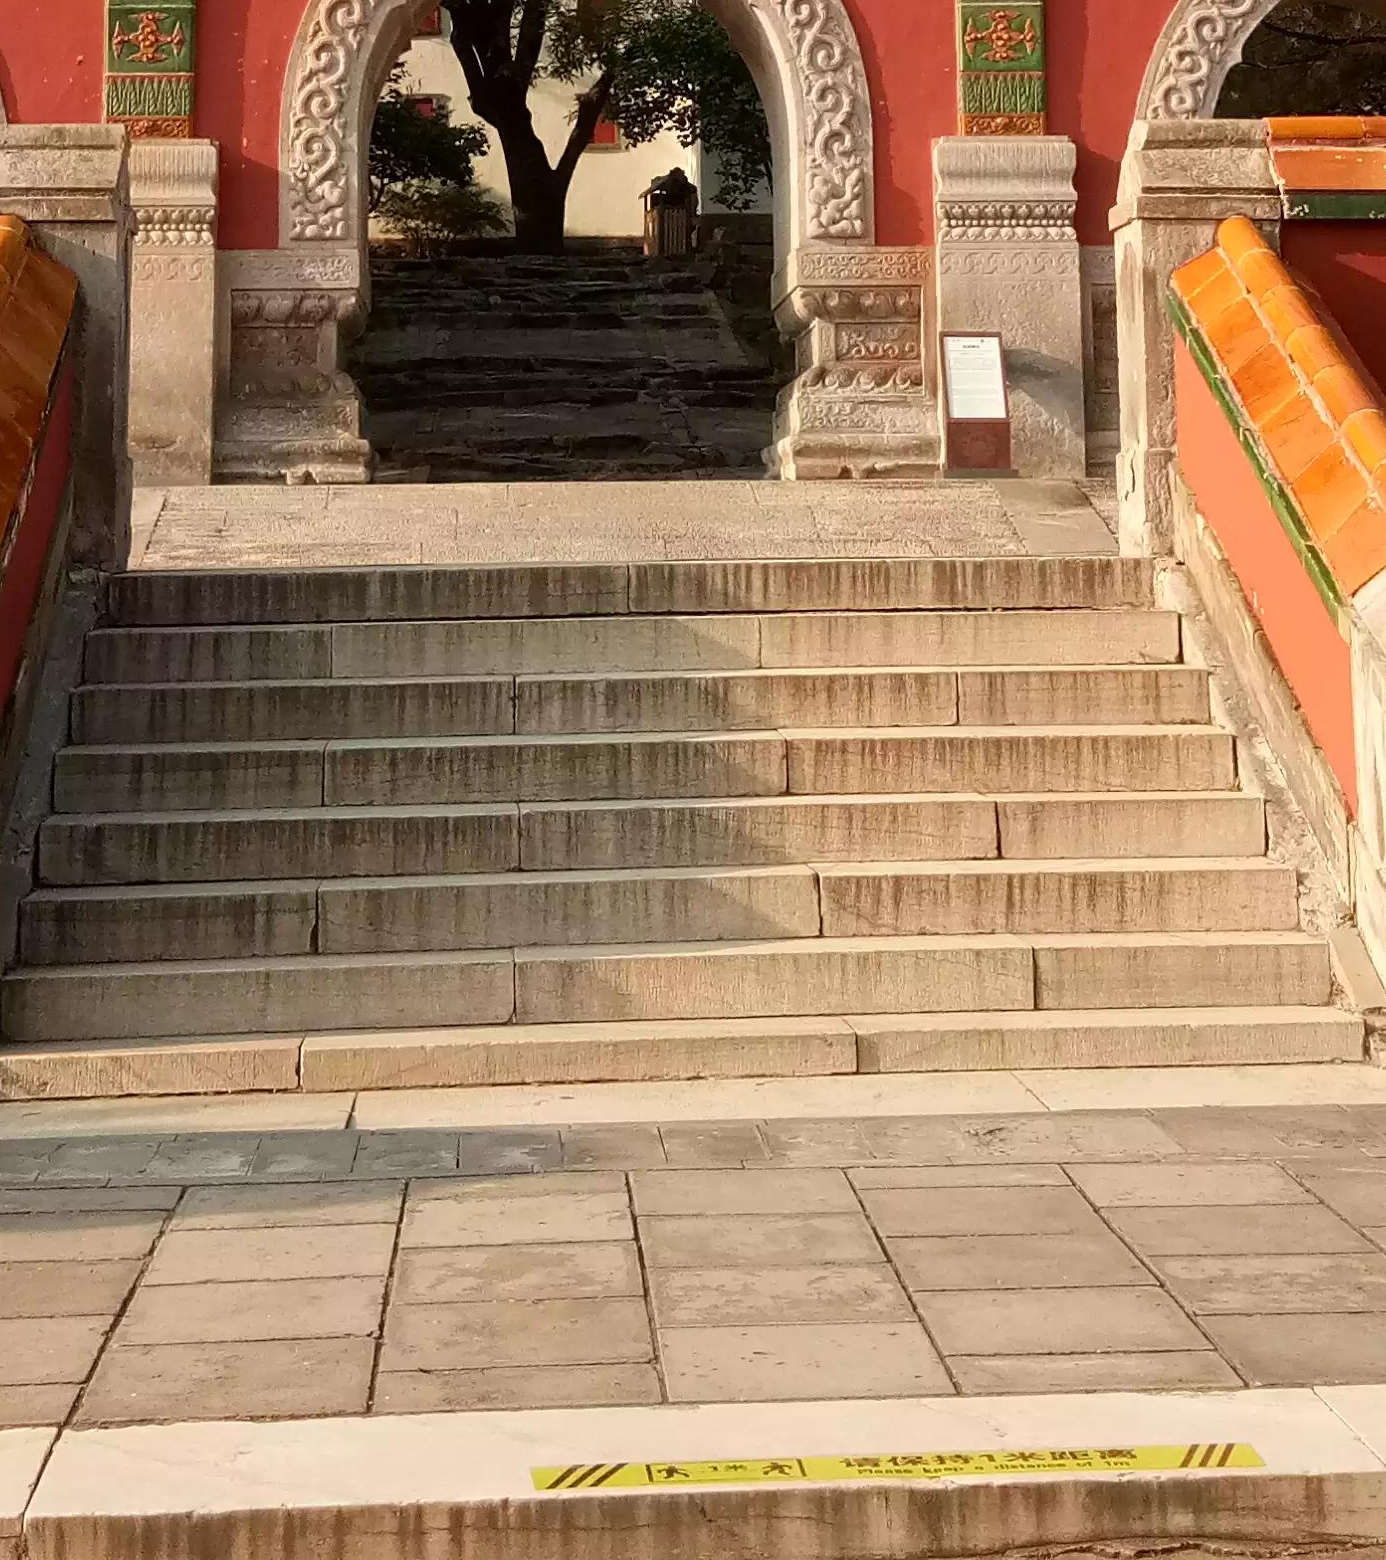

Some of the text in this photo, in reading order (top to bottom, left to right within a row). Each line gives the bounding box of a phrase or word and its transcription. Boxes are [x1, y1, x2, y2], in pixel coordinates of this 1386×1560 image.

[839, 1449, 1138, 1468] 请保持1米距离
